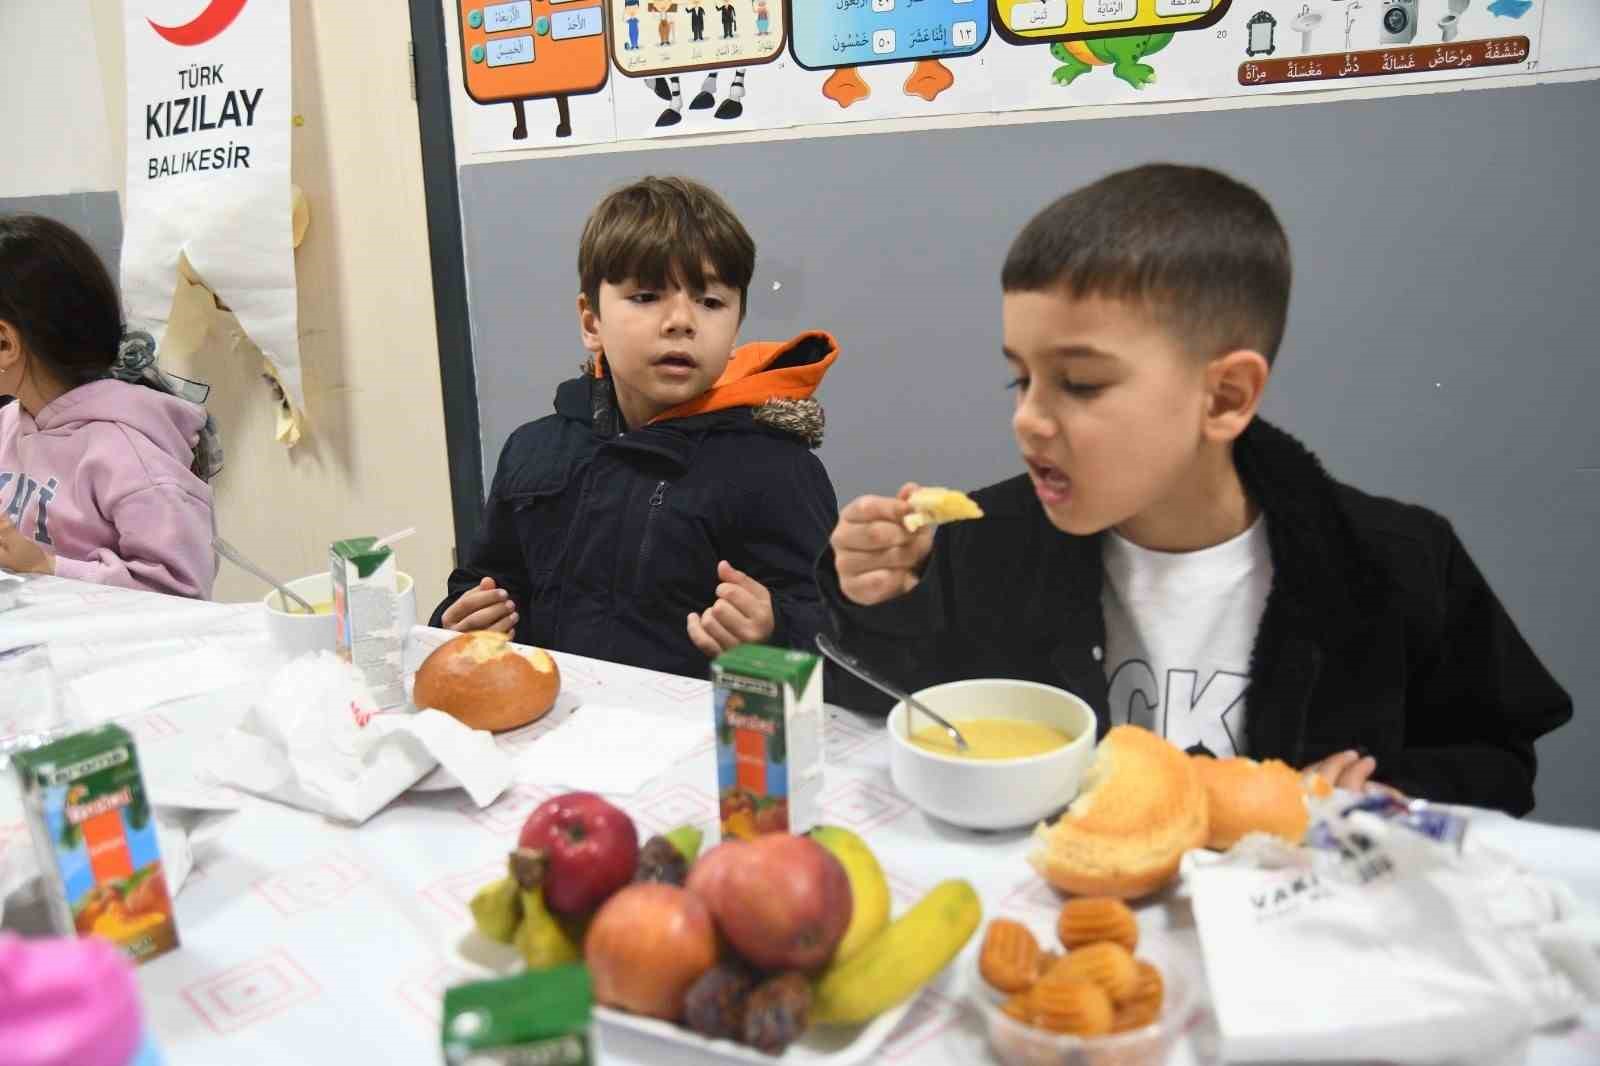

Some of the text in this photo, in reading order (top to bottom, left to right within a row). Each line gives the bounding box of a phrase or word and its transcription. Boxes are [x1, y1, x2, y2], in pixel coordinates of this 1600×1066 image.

[1216, 30, 1228, 40] 20
[178, 64, 225, 90] TÜRK
[146, 88, 264, 140] KIZILAY
[147, 141, 251, 180] BALIKESİR
